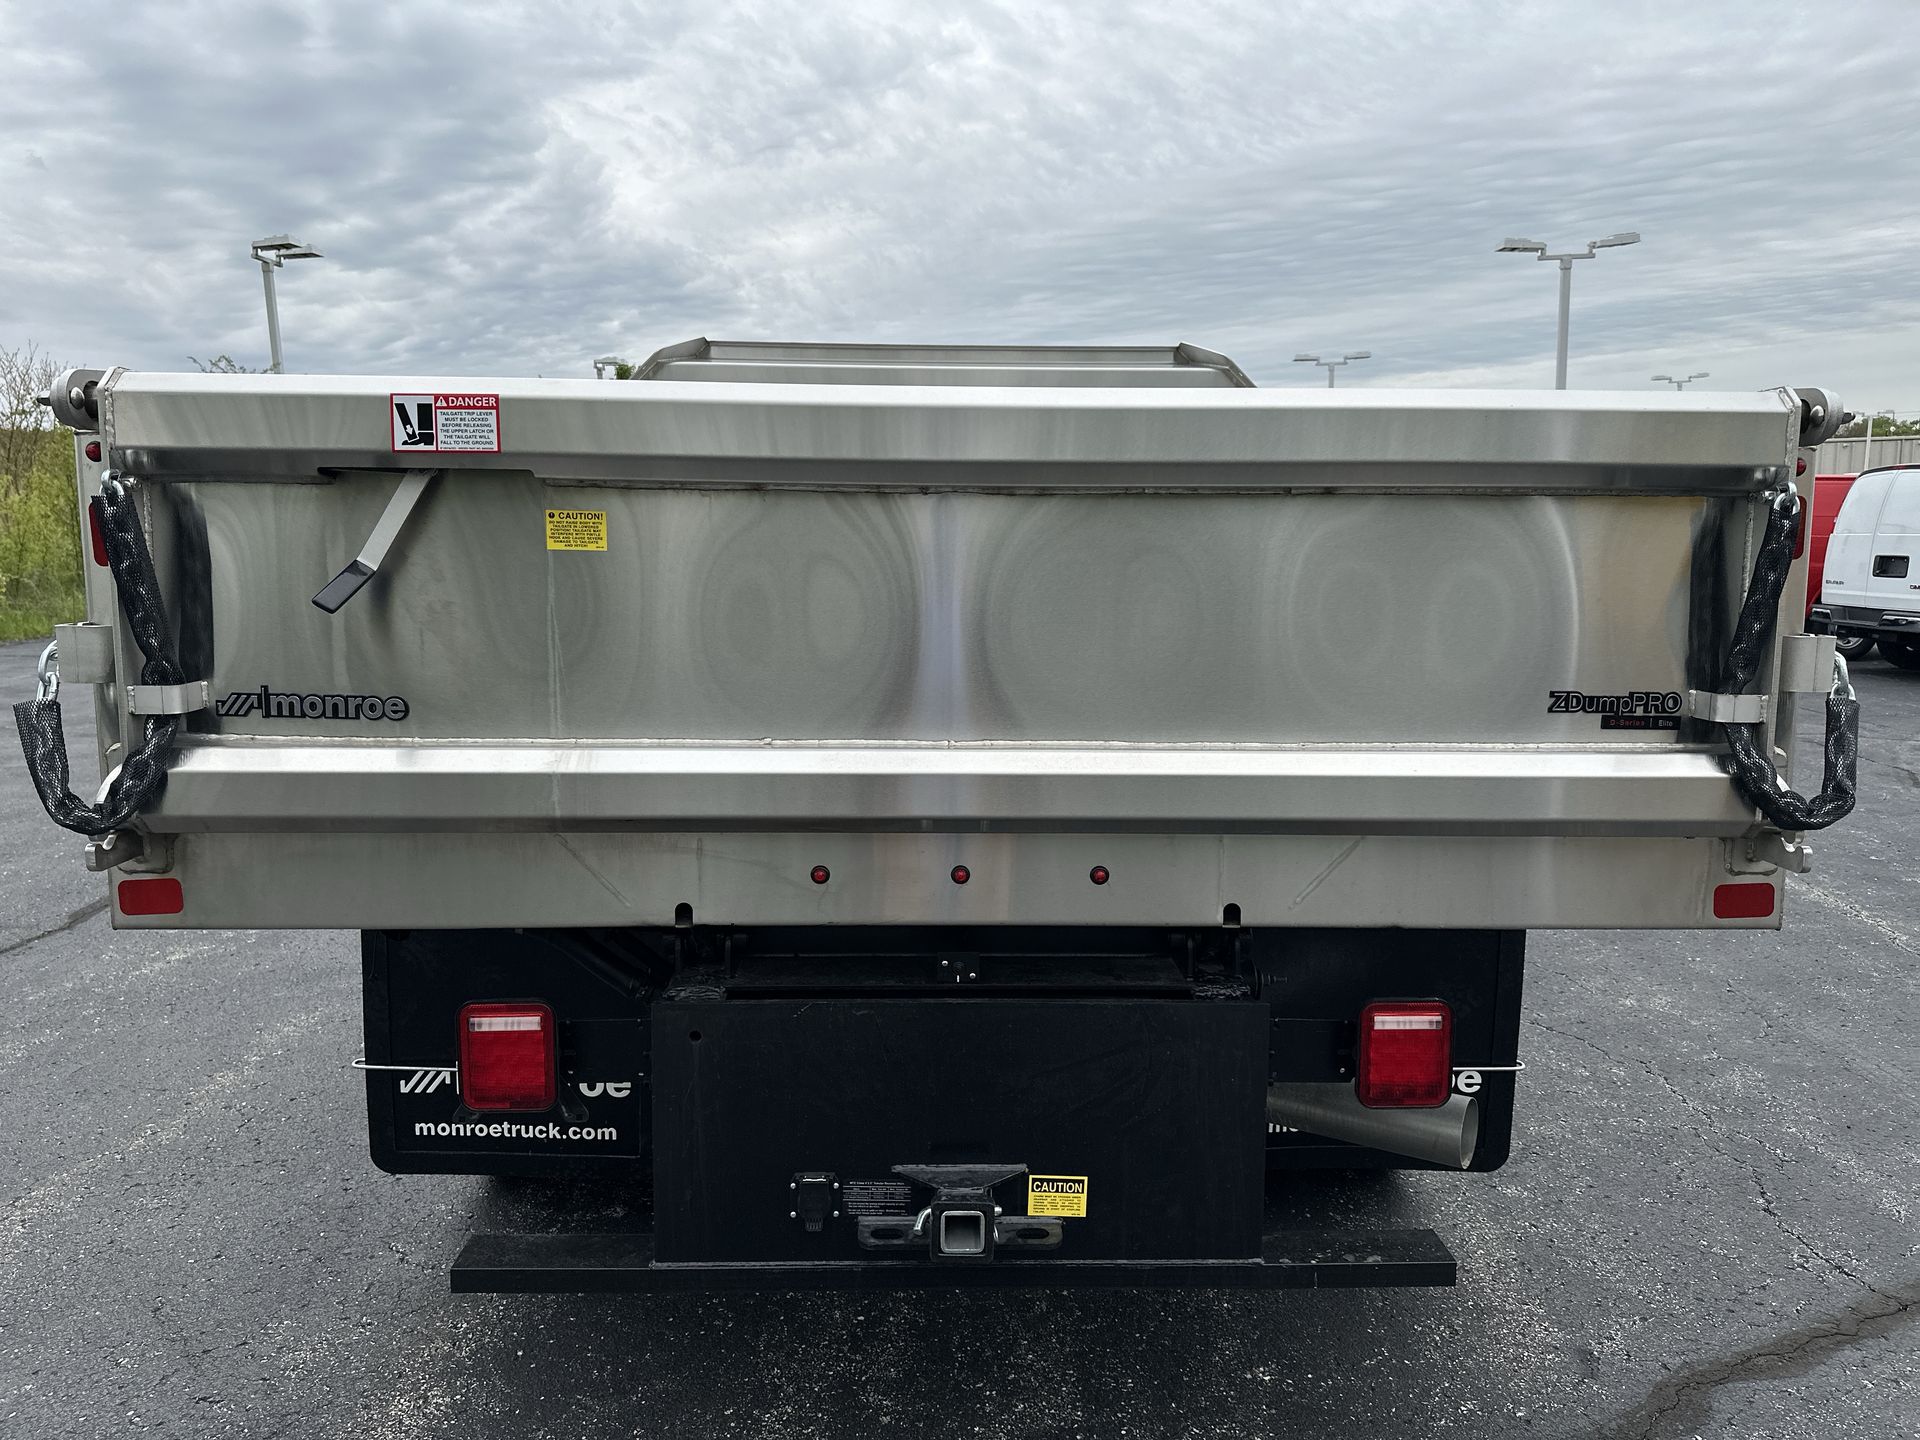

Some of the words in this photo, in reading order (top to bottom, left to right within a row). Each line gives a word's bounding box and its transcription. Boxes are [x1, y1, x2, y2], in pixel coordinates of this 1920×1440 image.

[449, 397, 496, 406] DANGER
[558, 512, 603, 520] CAUTION!
[269, 693, 409, 721] monroe
[1549, 692, 1682, 715] ZDumpPRO
[414, 1121, 617, 1140] monroetruck.com
[1033, 1182, 1082, 1192] CAUTION
